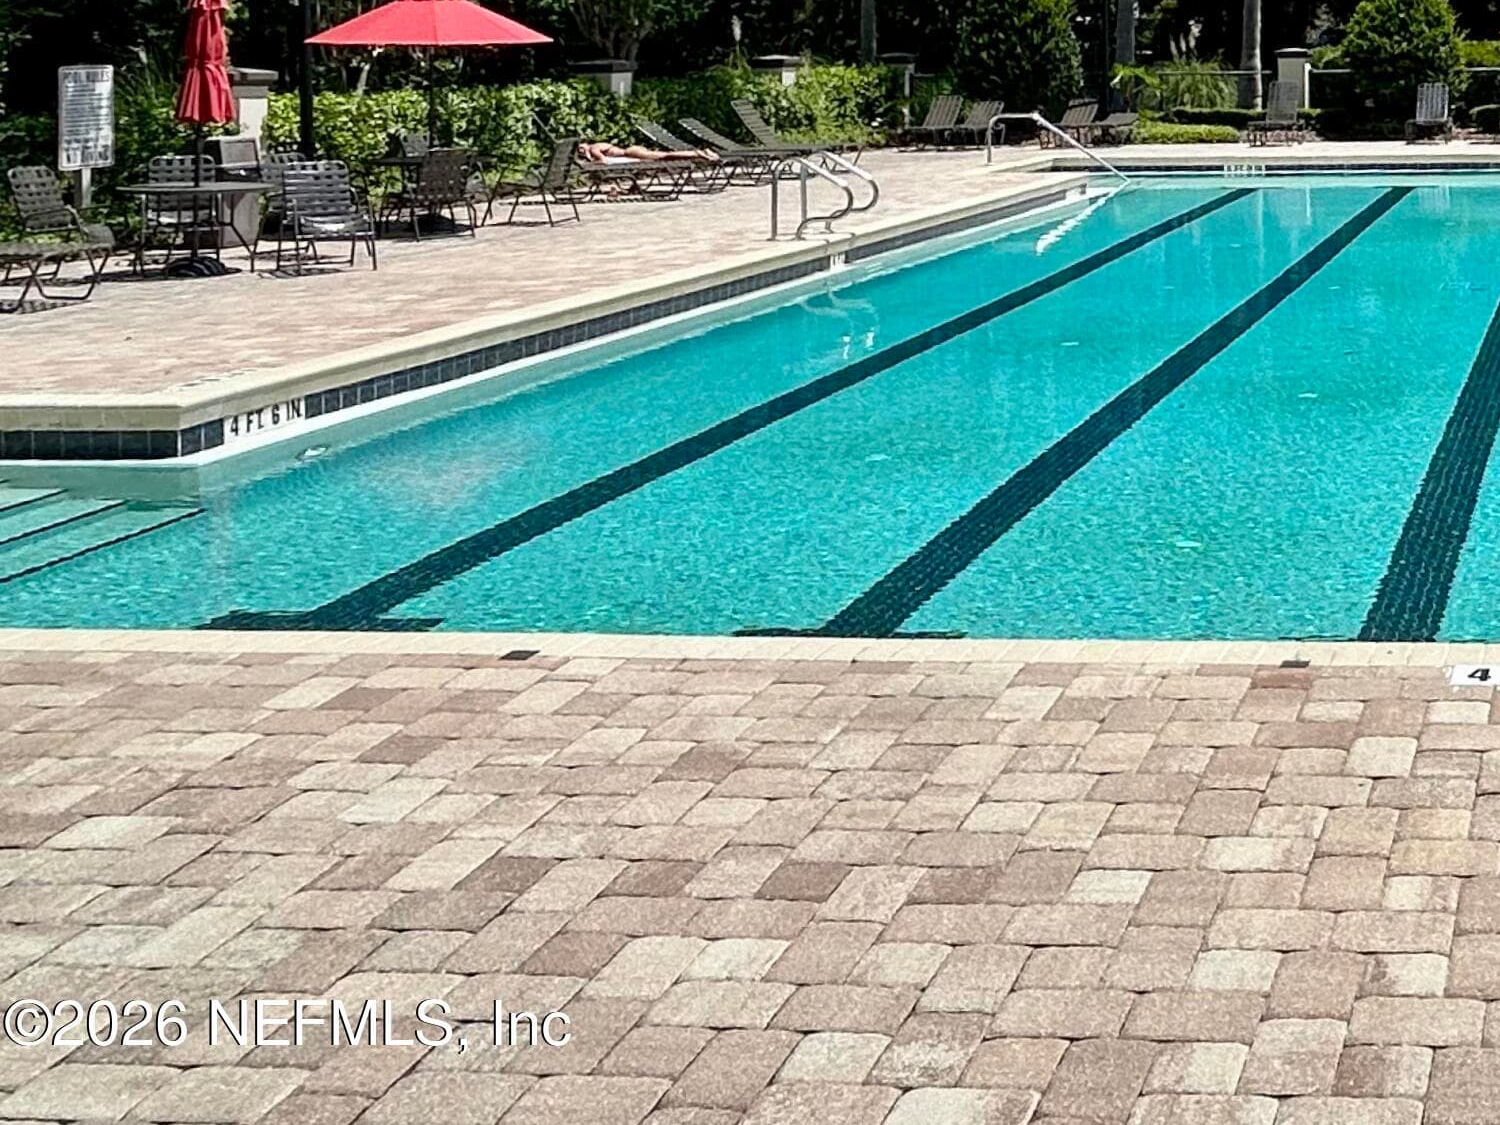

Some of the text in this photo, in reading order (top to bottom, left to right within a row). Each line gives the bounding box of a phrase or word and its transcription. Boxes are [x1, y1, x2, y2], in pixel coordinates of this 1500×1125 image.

[230, 415, 239, 436] 4
[272, 403, 281, 425] 6
[1467, 668, 1491, 681] 4
